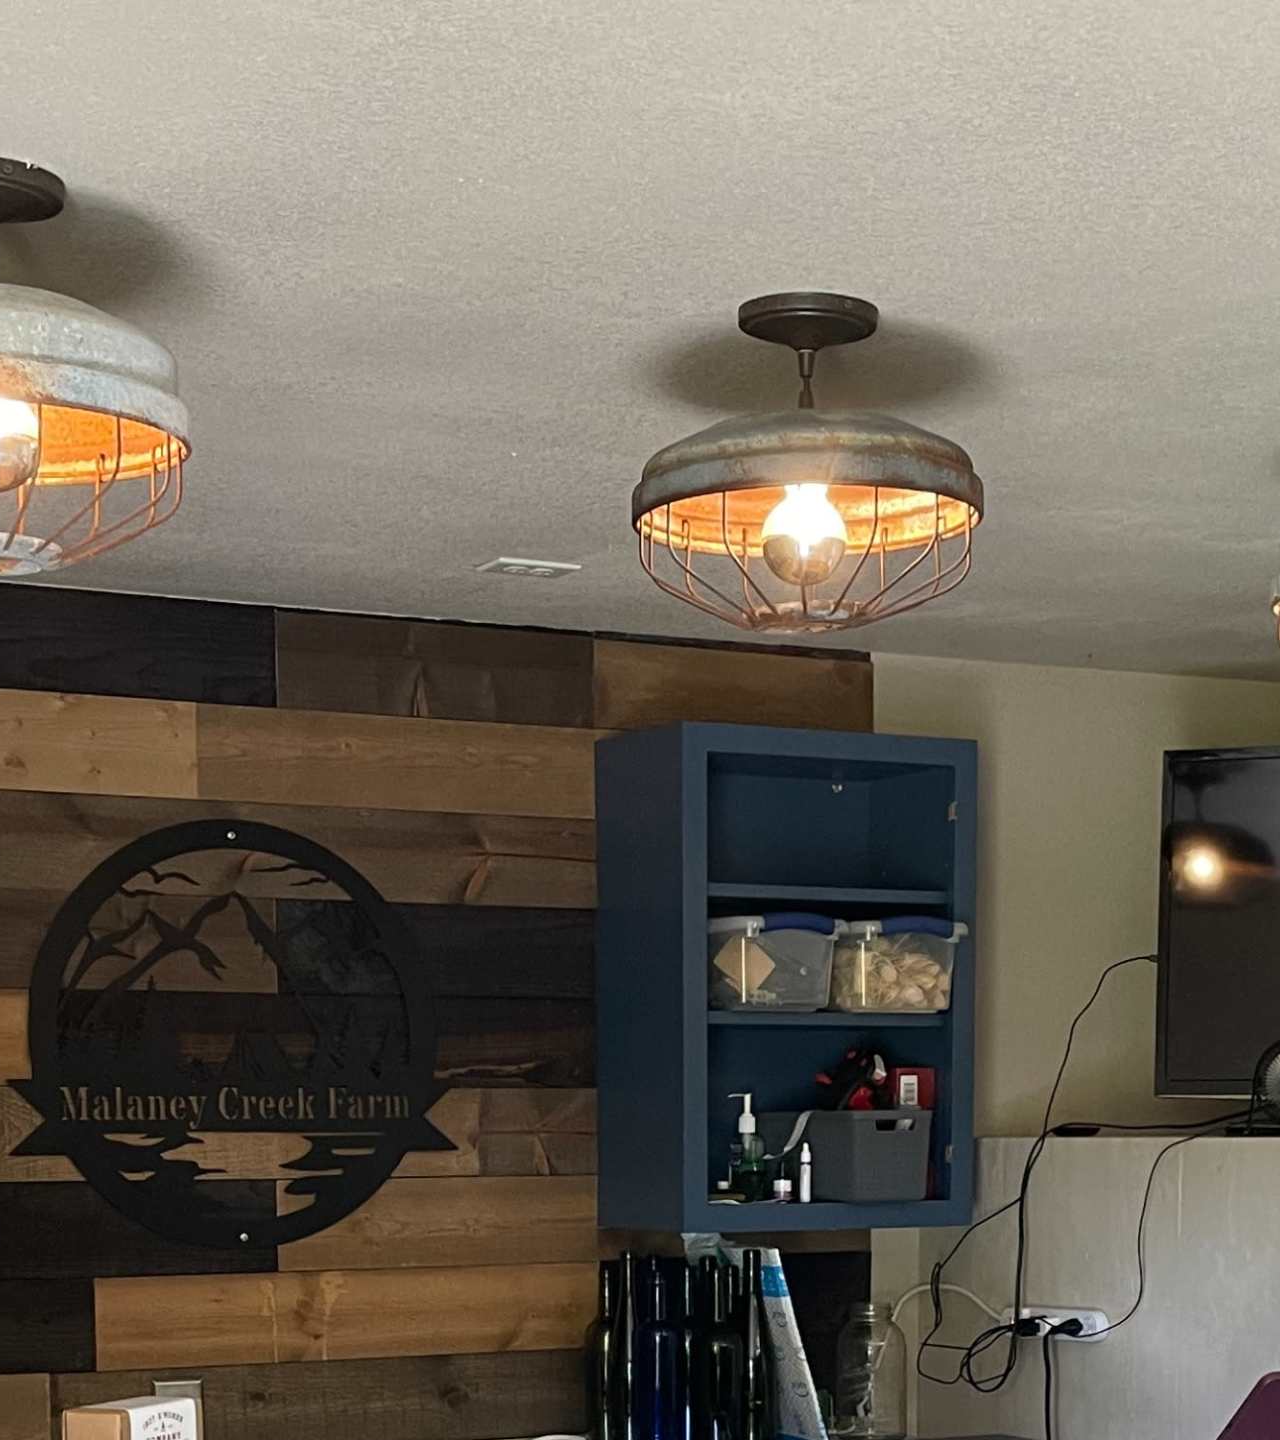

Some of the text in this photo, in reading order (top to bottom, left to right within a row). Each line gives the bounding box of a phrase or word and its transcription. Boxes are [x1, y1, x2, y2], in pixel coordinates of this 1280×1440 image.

[60, 1086, 410, 1129] Malaney Creek Farm
